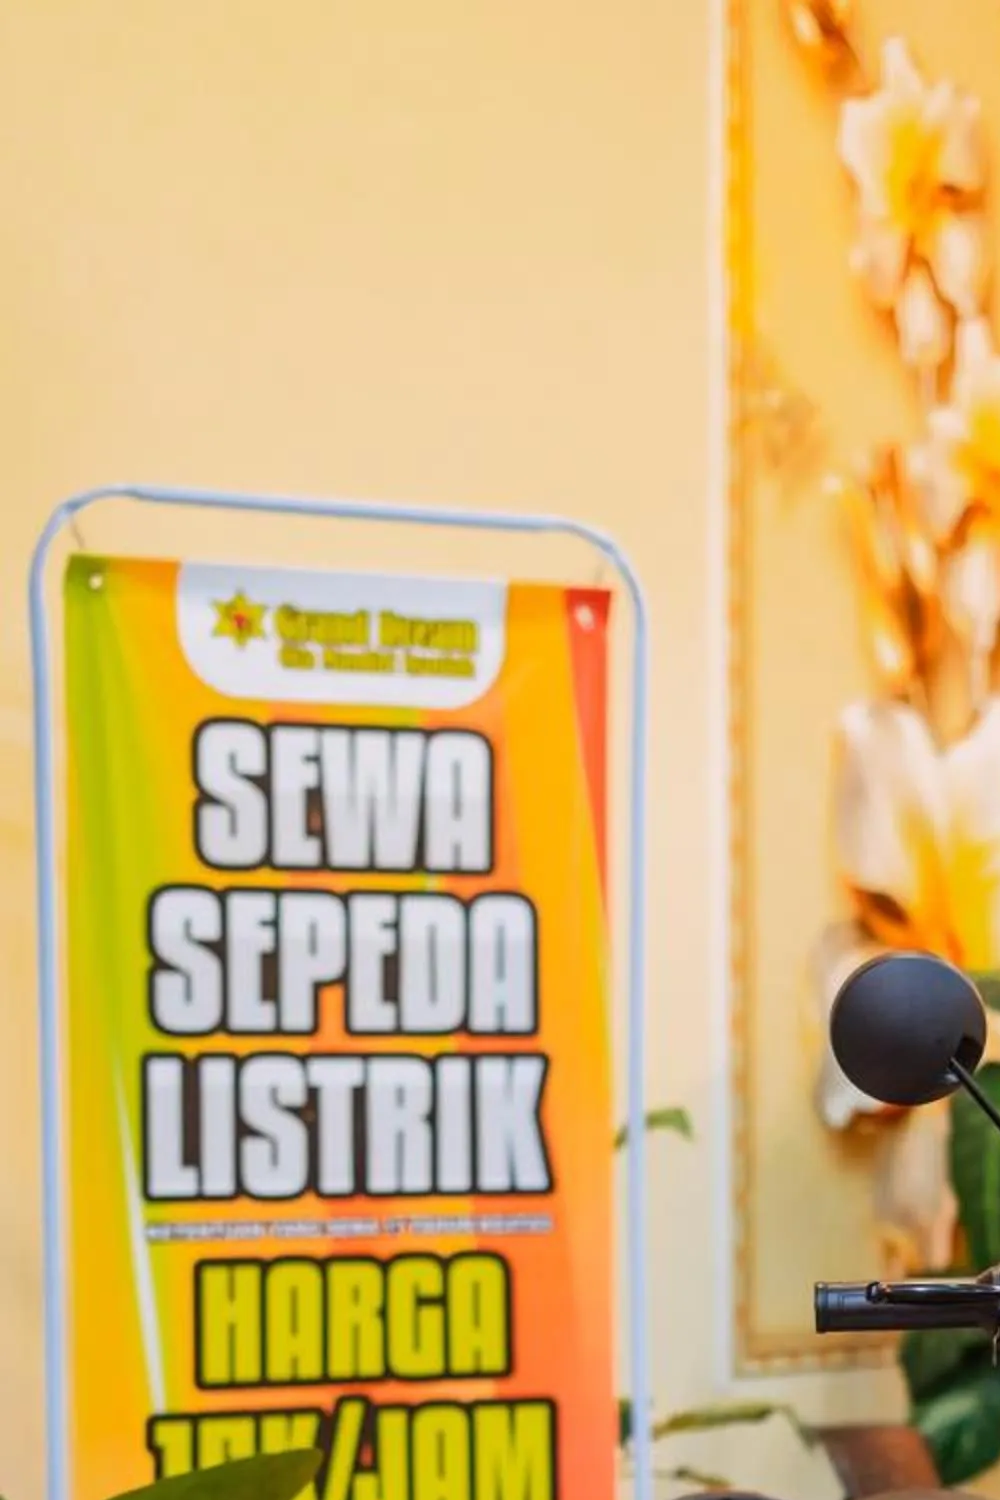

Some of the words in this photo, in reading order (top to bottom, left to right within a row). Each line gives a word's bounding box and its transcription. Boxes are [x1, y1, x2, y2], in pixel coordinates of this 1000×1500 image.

[192, 717, 494, 875] SEWA
[147, 882, 540, 1038] SEPEDA
[140, 1050, 554, 1202] LISTRIK
[195, 1251, 513, 1388] HARGA
